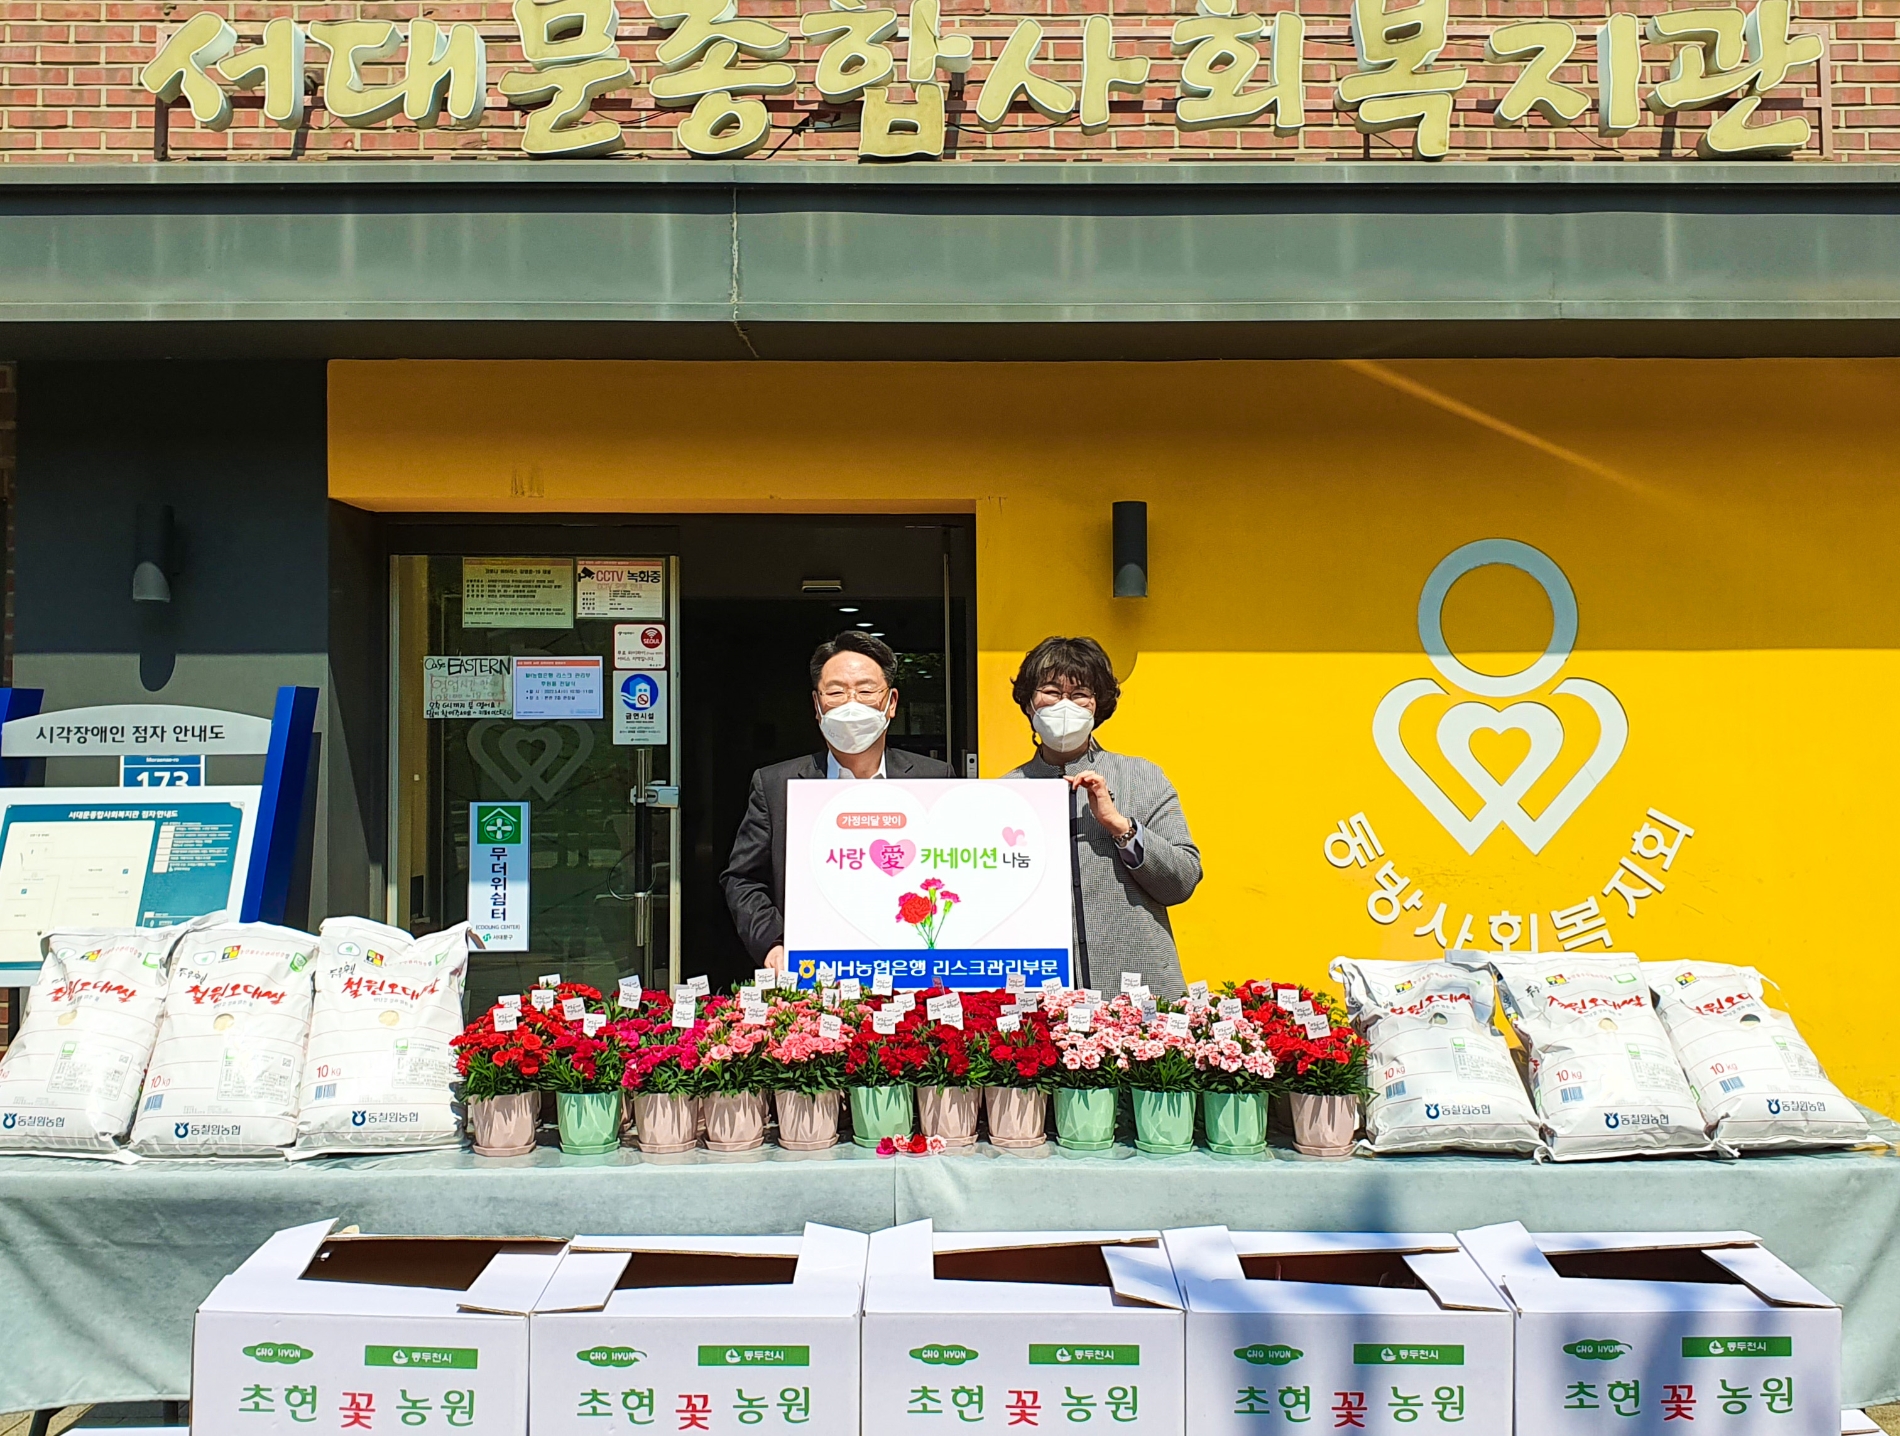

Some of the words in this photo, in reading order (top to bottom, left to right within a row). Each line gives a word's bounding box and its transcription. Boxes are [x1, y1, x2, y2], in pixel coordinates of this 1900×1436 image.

[596, 570, 624, 582] CCTV
[627, 569, 661, 583] 녹화중
[447, 656, 511, 676] EASTERN
[625, 712, 654, 720] 금연시설
[36, 725, 126, 744] 시각장애인
[132, 724, 167, 744] 점자
[173, 724, 226, 742] 안내도
[841, 815, 880, 827] 가정의달
[882, 815, 902, 827] 맞이
[825, 847, 866, 870] 사랑
[882, 844, 905, 870] 愛
[920, 846, 998, 870] 카네이션
[1002, 852, 1031, 868] 나눔
[490, 847, 508, 921] 무더위쉼터
[819, 960, 926, 977] NH농협은행
[316, 1064, 328, 1078] 10
[331, 1067, 342, 1076] kg
[1384, 1068, 1394, 1080] 10
[1396, 1066, 1406, 1074] kg
[1556, 1069, 1569, 1082] 10
[1572, 1070, 1582, 1080] kg
[1710, 1062, 1724, 1076] 10
[1726, 1062, 1738, 1071] kg
[151, 1075, 162, 1088] 10
[1441, 1103, 1491, 1116] 동철원농협
[1782, 1100, 1826, 1112] 동철원농협
[18, 1114, 65, 1128] 동철원농협
[368, 1112, 420, 1124] 동철원농협
[1620, 1112, 1670, 1126] 동철원농협
[190, 1124, 241, 1137] 동철원농협
[255, 1346, 275, 1358] CHO
[1576, 1344, 1594, 1354] CHO
[1726, 1340, 1766, 1352] 동두천시
[412, 1350, 452, 1364] 동두천시
[589, 1350, 608, 1362] CHO
[743, 1348, 785, 1362] 동두천시
[922, 1350, 940, 1360] CHO
[1074, 1348, 1114, 1360] 동두천시
[1246, 1350, 1264, 1360] CHO
[1398, 1348, 1439, 1360] 동두천시
[907, 1385, 984, 1422] 초현
[1004, 1388, 1041, 1426] 꽃
[1060, 1385, 1138, 1422] 농원
[1564, 1378, 1641, 1416] 초현
[1660, 1383, 1697, 1422] 꽃
[1716, 1376, 1794, 1414] 농원
[239, 1384, 318, 1424] 초현
[338, 1390, 376, 1430] 꽃
[396, 1388, 476, 1427] 농원
[576, 1387, 655, 1425] 초현
[675, 1393, 713, 1430] 꽃
[732, 1385, 810, 1425] 농원
[1234, 1385, 1312, 1422] 초현
[1331, 1391, 1368, 1429] 꽃
[1388, 1385, 1466, 1422] 농원
